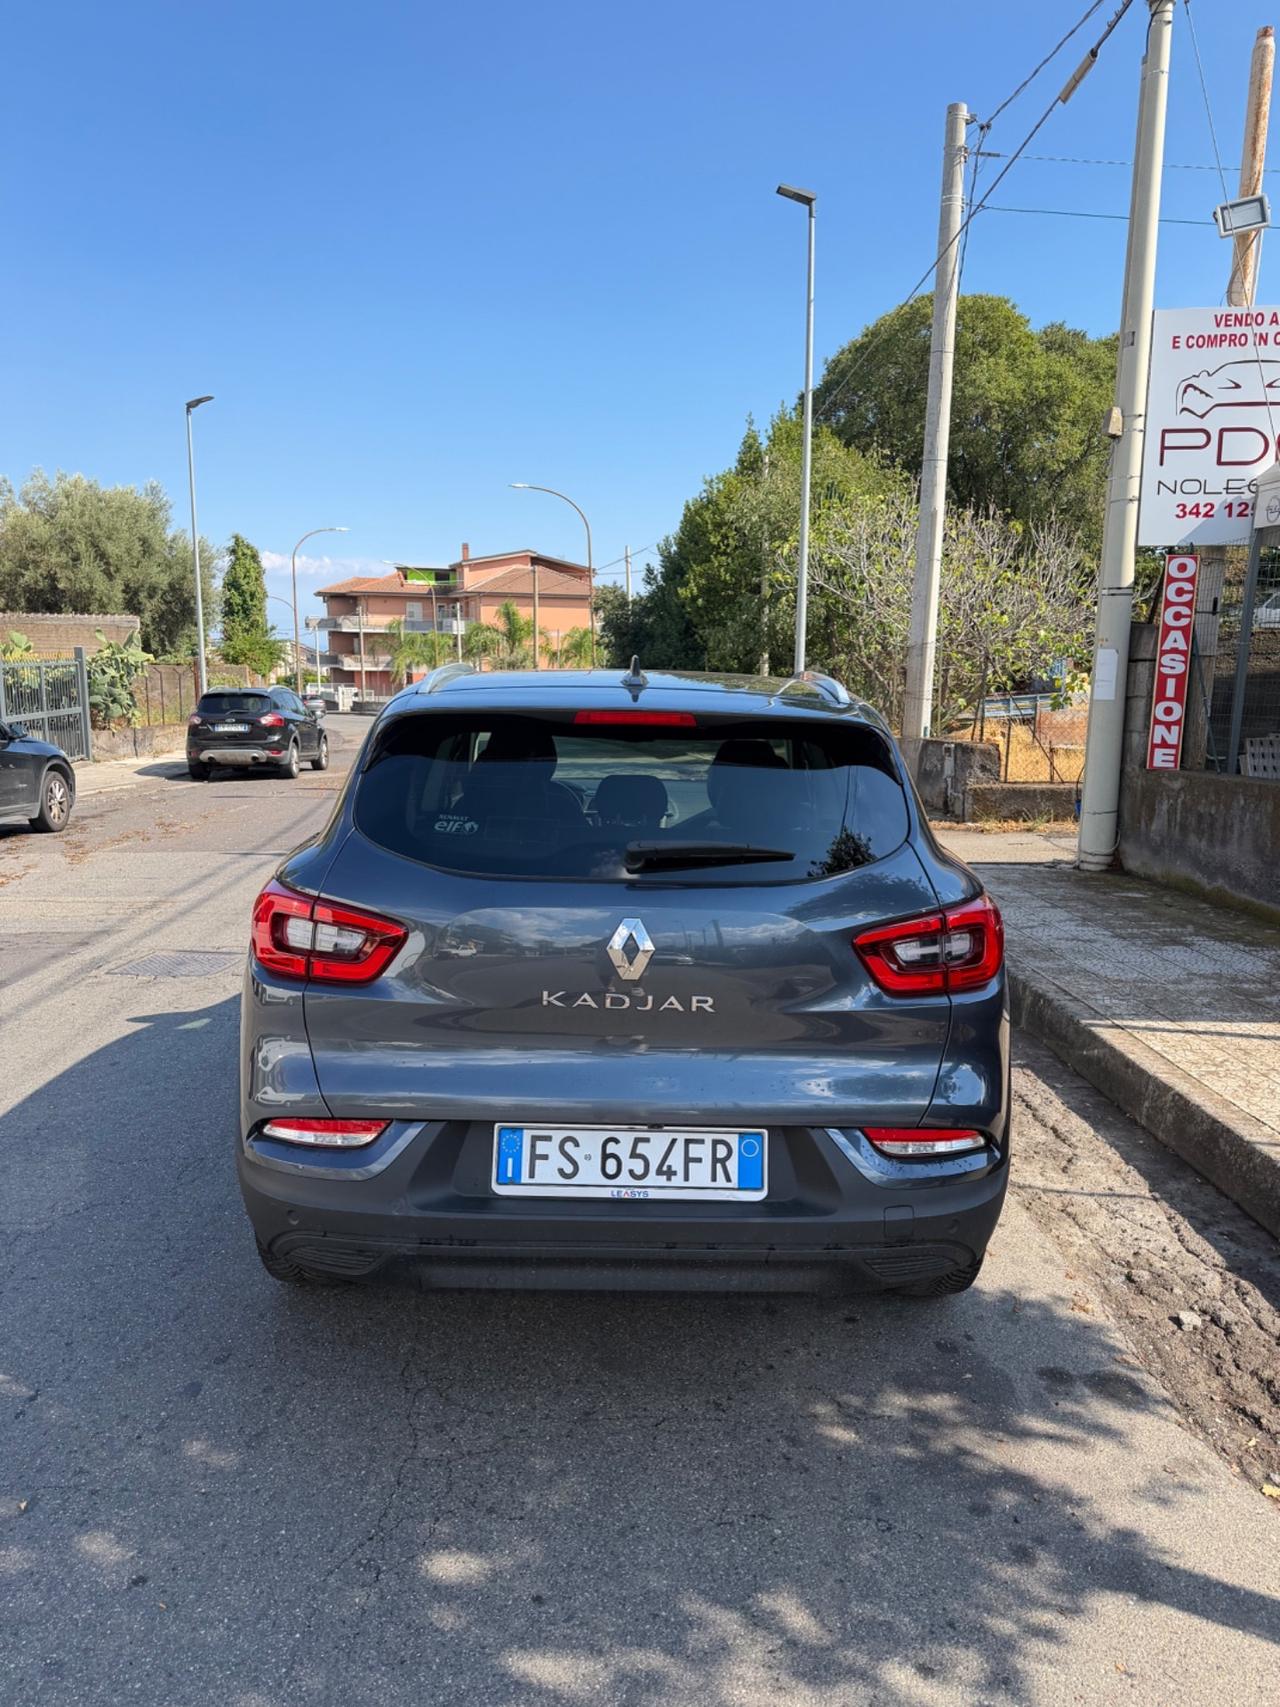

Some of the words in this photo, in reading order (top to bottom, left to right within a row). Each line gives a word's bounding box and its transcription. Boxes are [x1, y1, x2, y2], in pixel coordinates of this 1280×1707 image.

[1214, 312, 1265, 328] VENDO
[1172, 335, 1181, 349] E
[1186, 333, 1248, 349] COMPRO
[1253, 332, 1268, 346] IN
[1175, 502, 1215, 519] 342
[1152, 557, 1197, 768] OCCASIONE
[542, 990, 716, 1013] KADJAR
[610, 1190, 649, 1198] LEASYS
